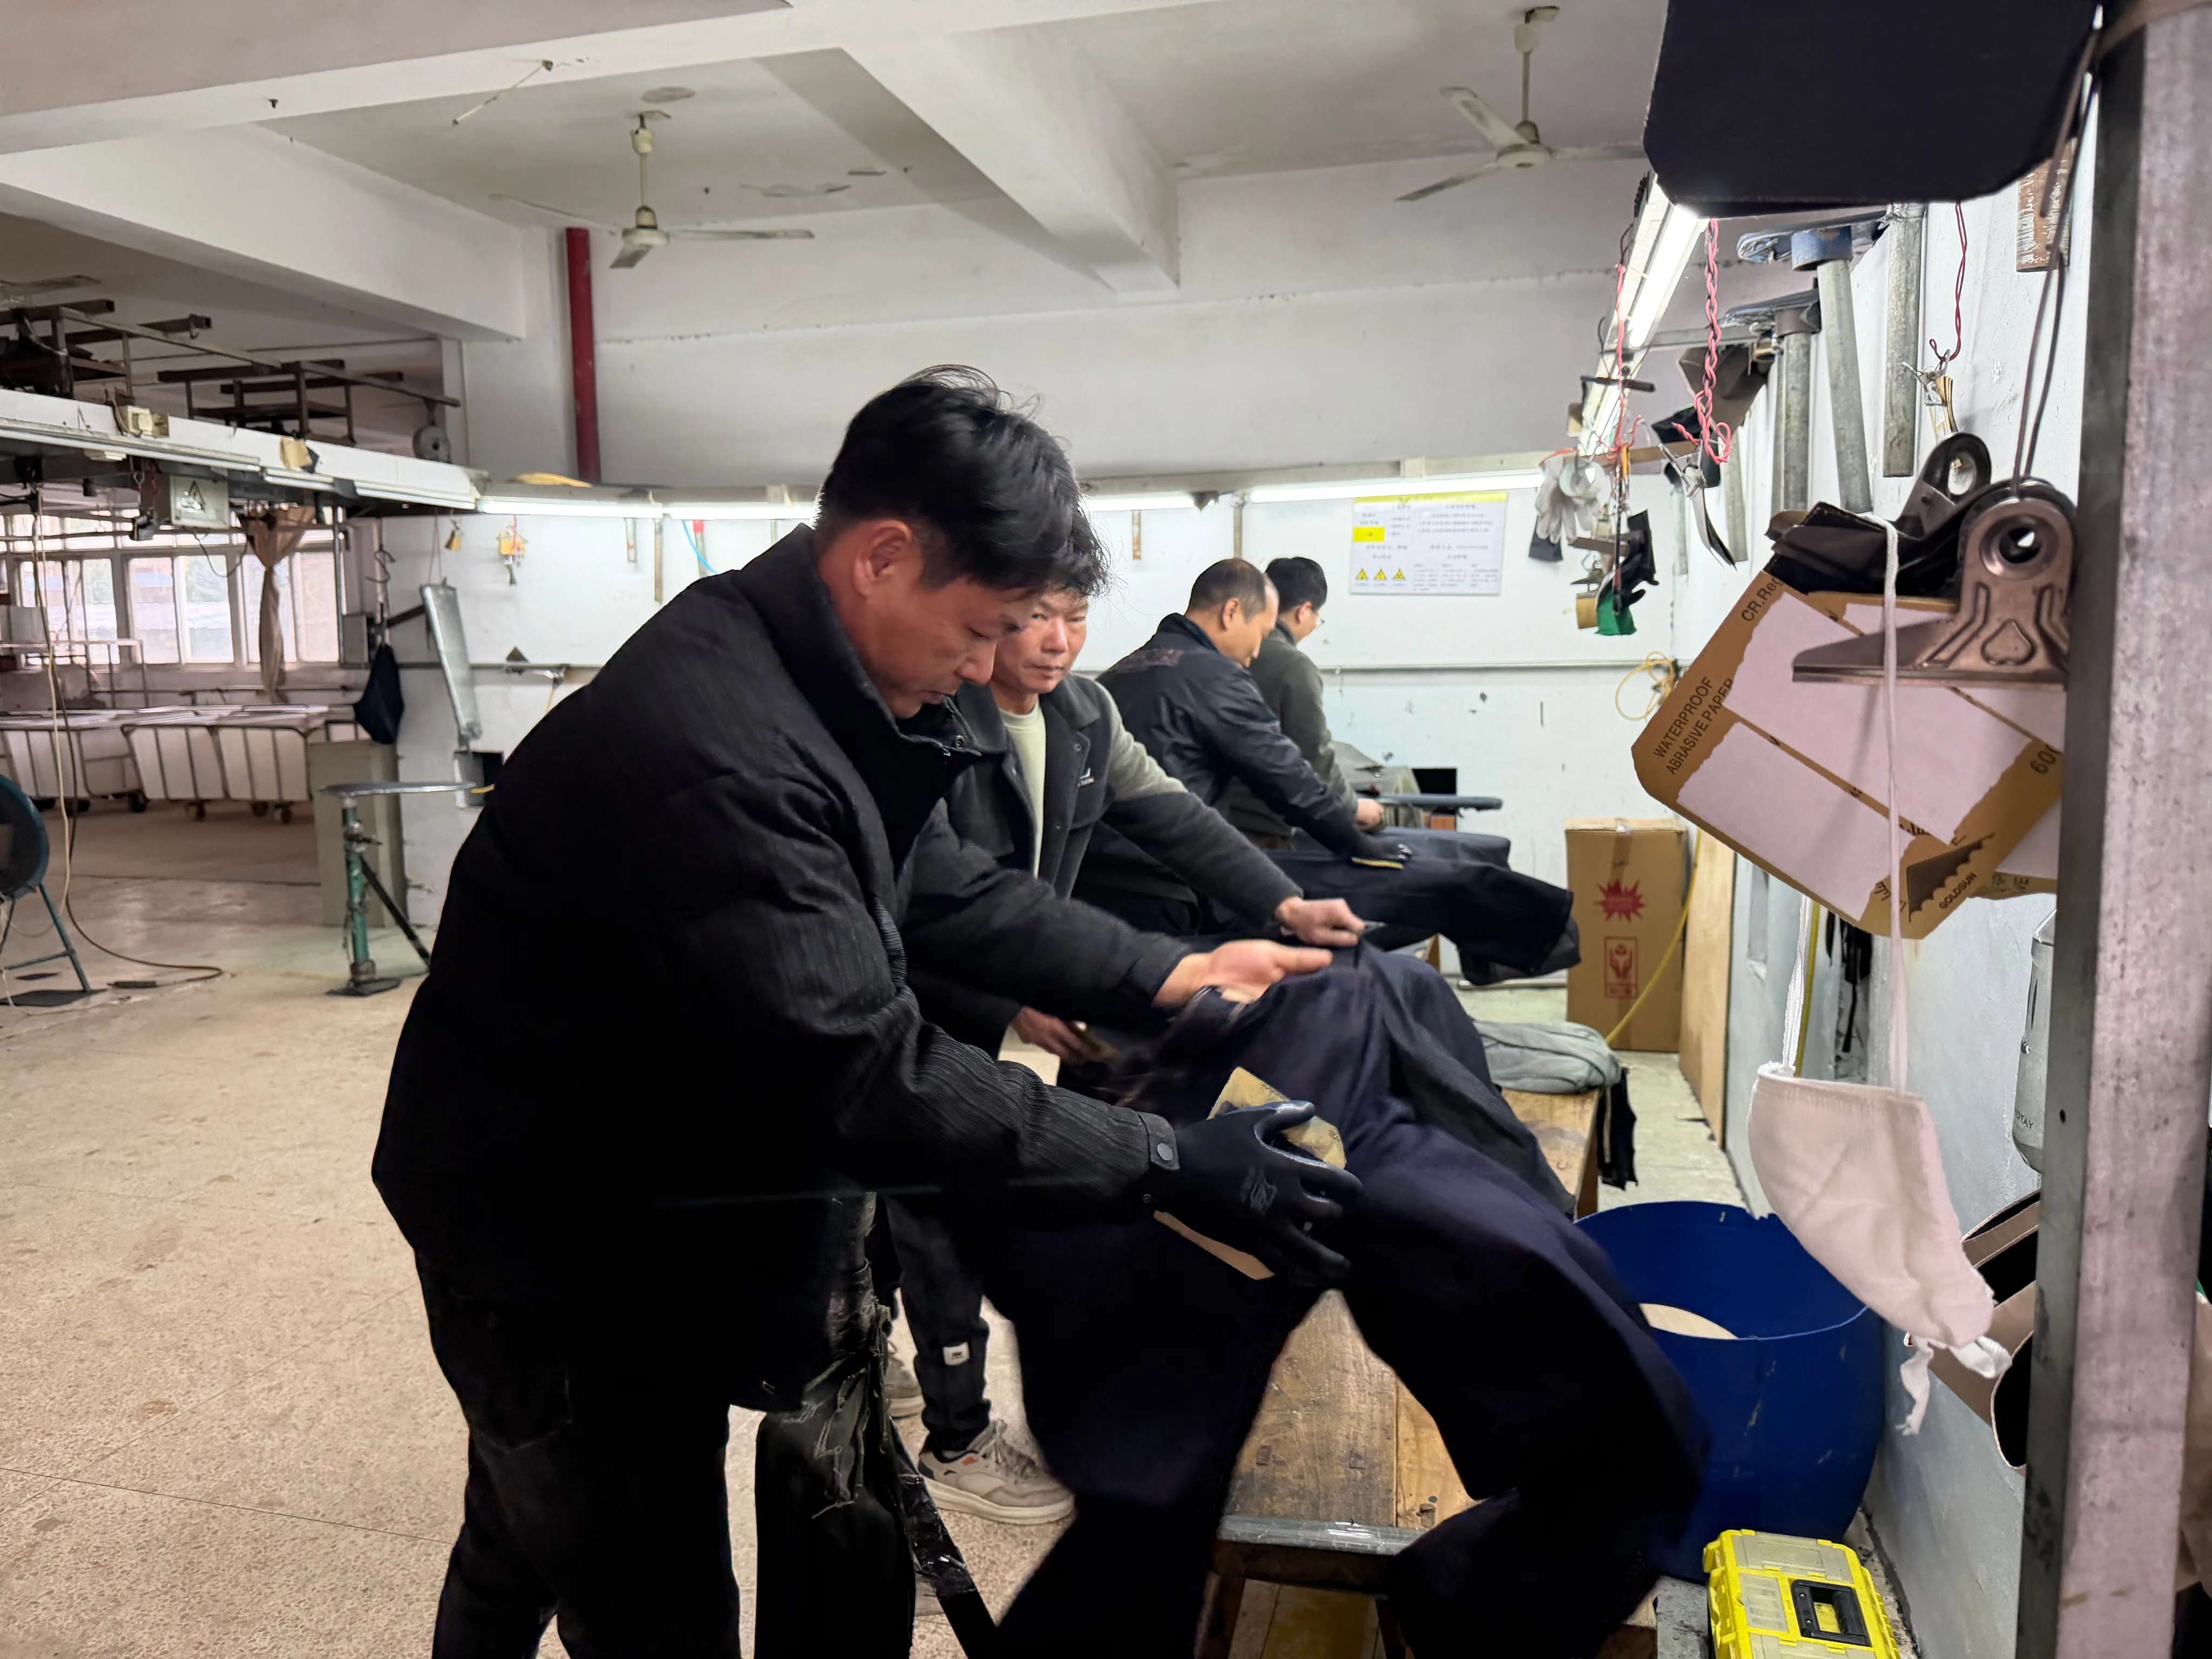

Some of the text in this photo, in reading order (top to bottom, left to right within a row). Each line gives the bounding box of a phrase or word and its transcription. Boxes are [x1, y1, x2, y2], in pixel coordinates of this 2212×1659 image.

[1653, 677, 1712, 757] WATERPROOF
[1665, 720, 1709, 775] ABRASIVE
[1939, 872, 1978, 909] GOLDSUN
[2014, 1108, 2034, 1129] OTAY
